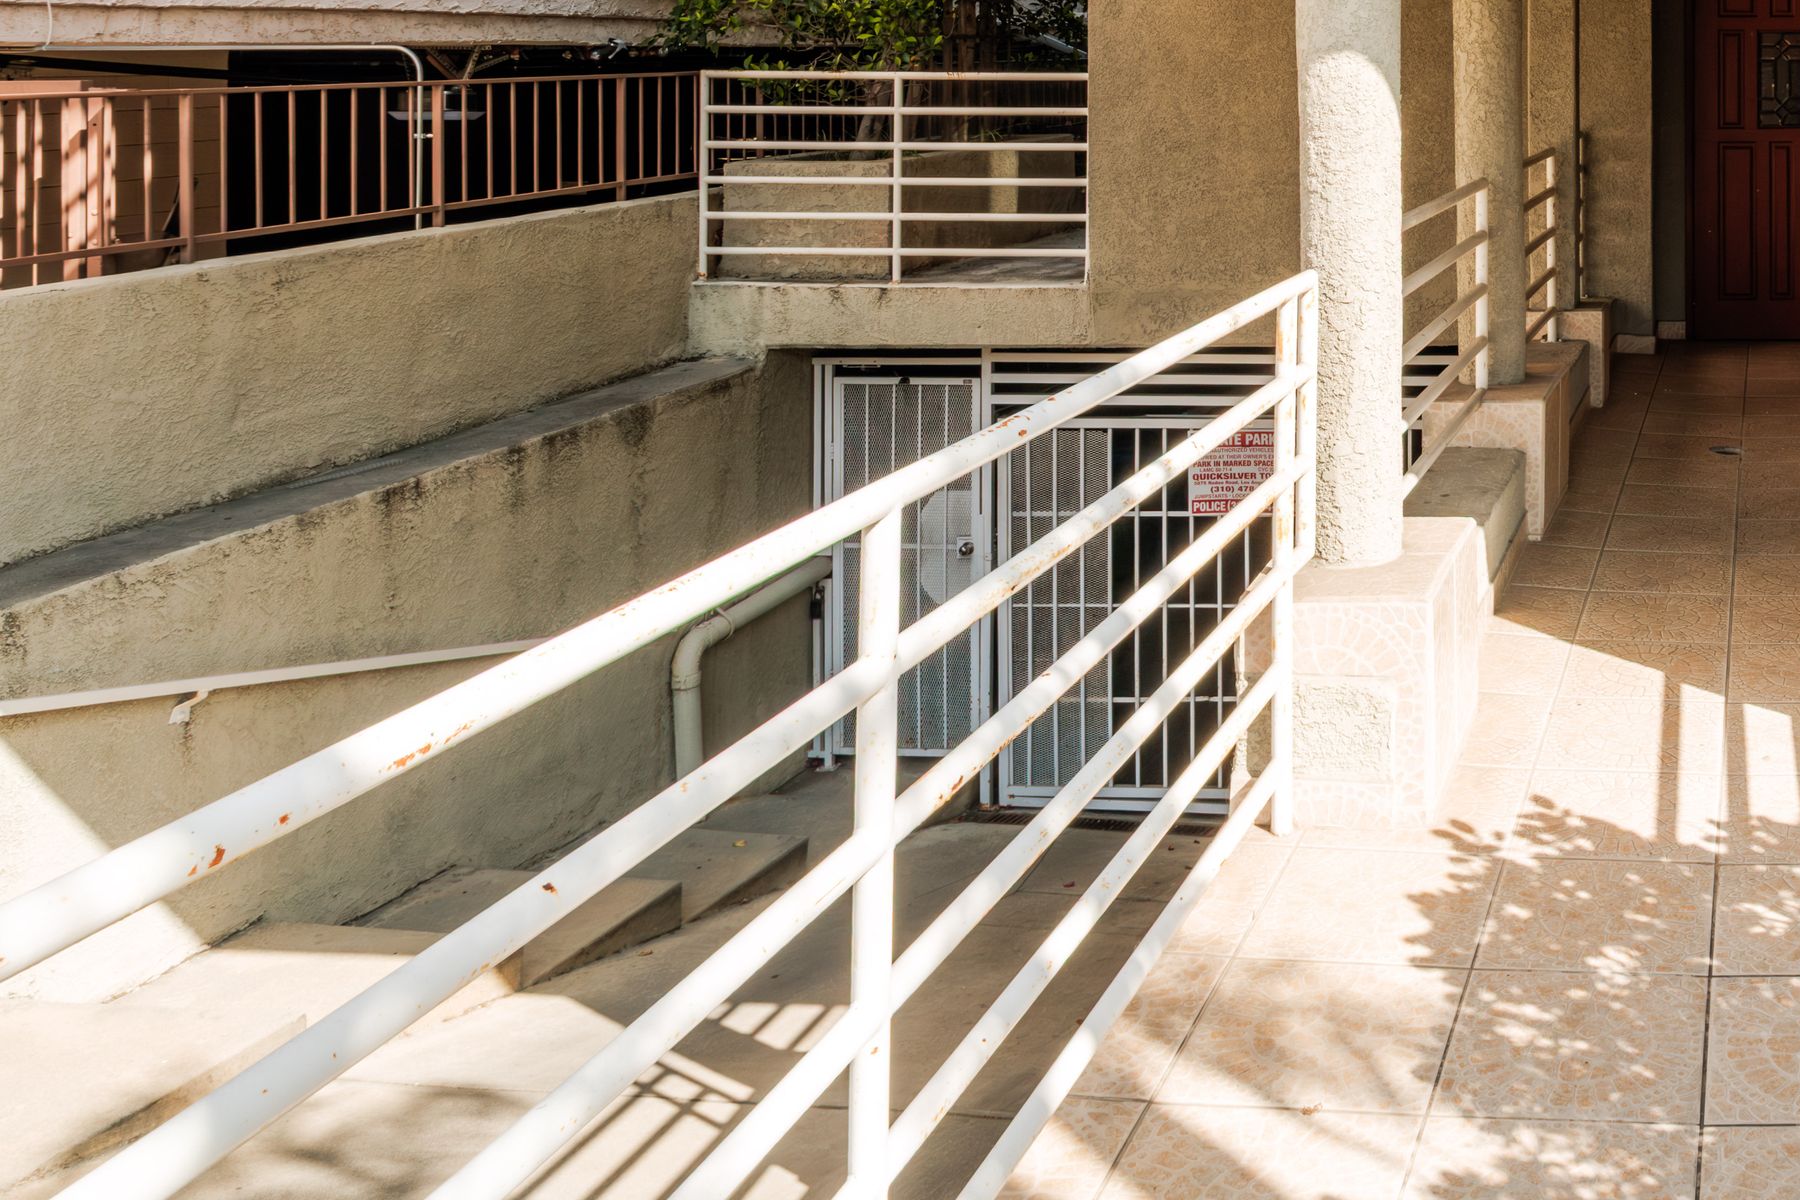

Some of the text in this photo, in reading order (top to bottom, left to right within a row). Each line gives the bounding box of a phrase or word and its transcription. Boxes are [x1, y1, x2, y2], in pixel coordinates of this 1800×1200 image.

[1192, 472, 1257, 481] QUICKSILVER
[1210, 485, 1255, 493] (310) 478
[1193, 501, 1227, 513] POLICE
